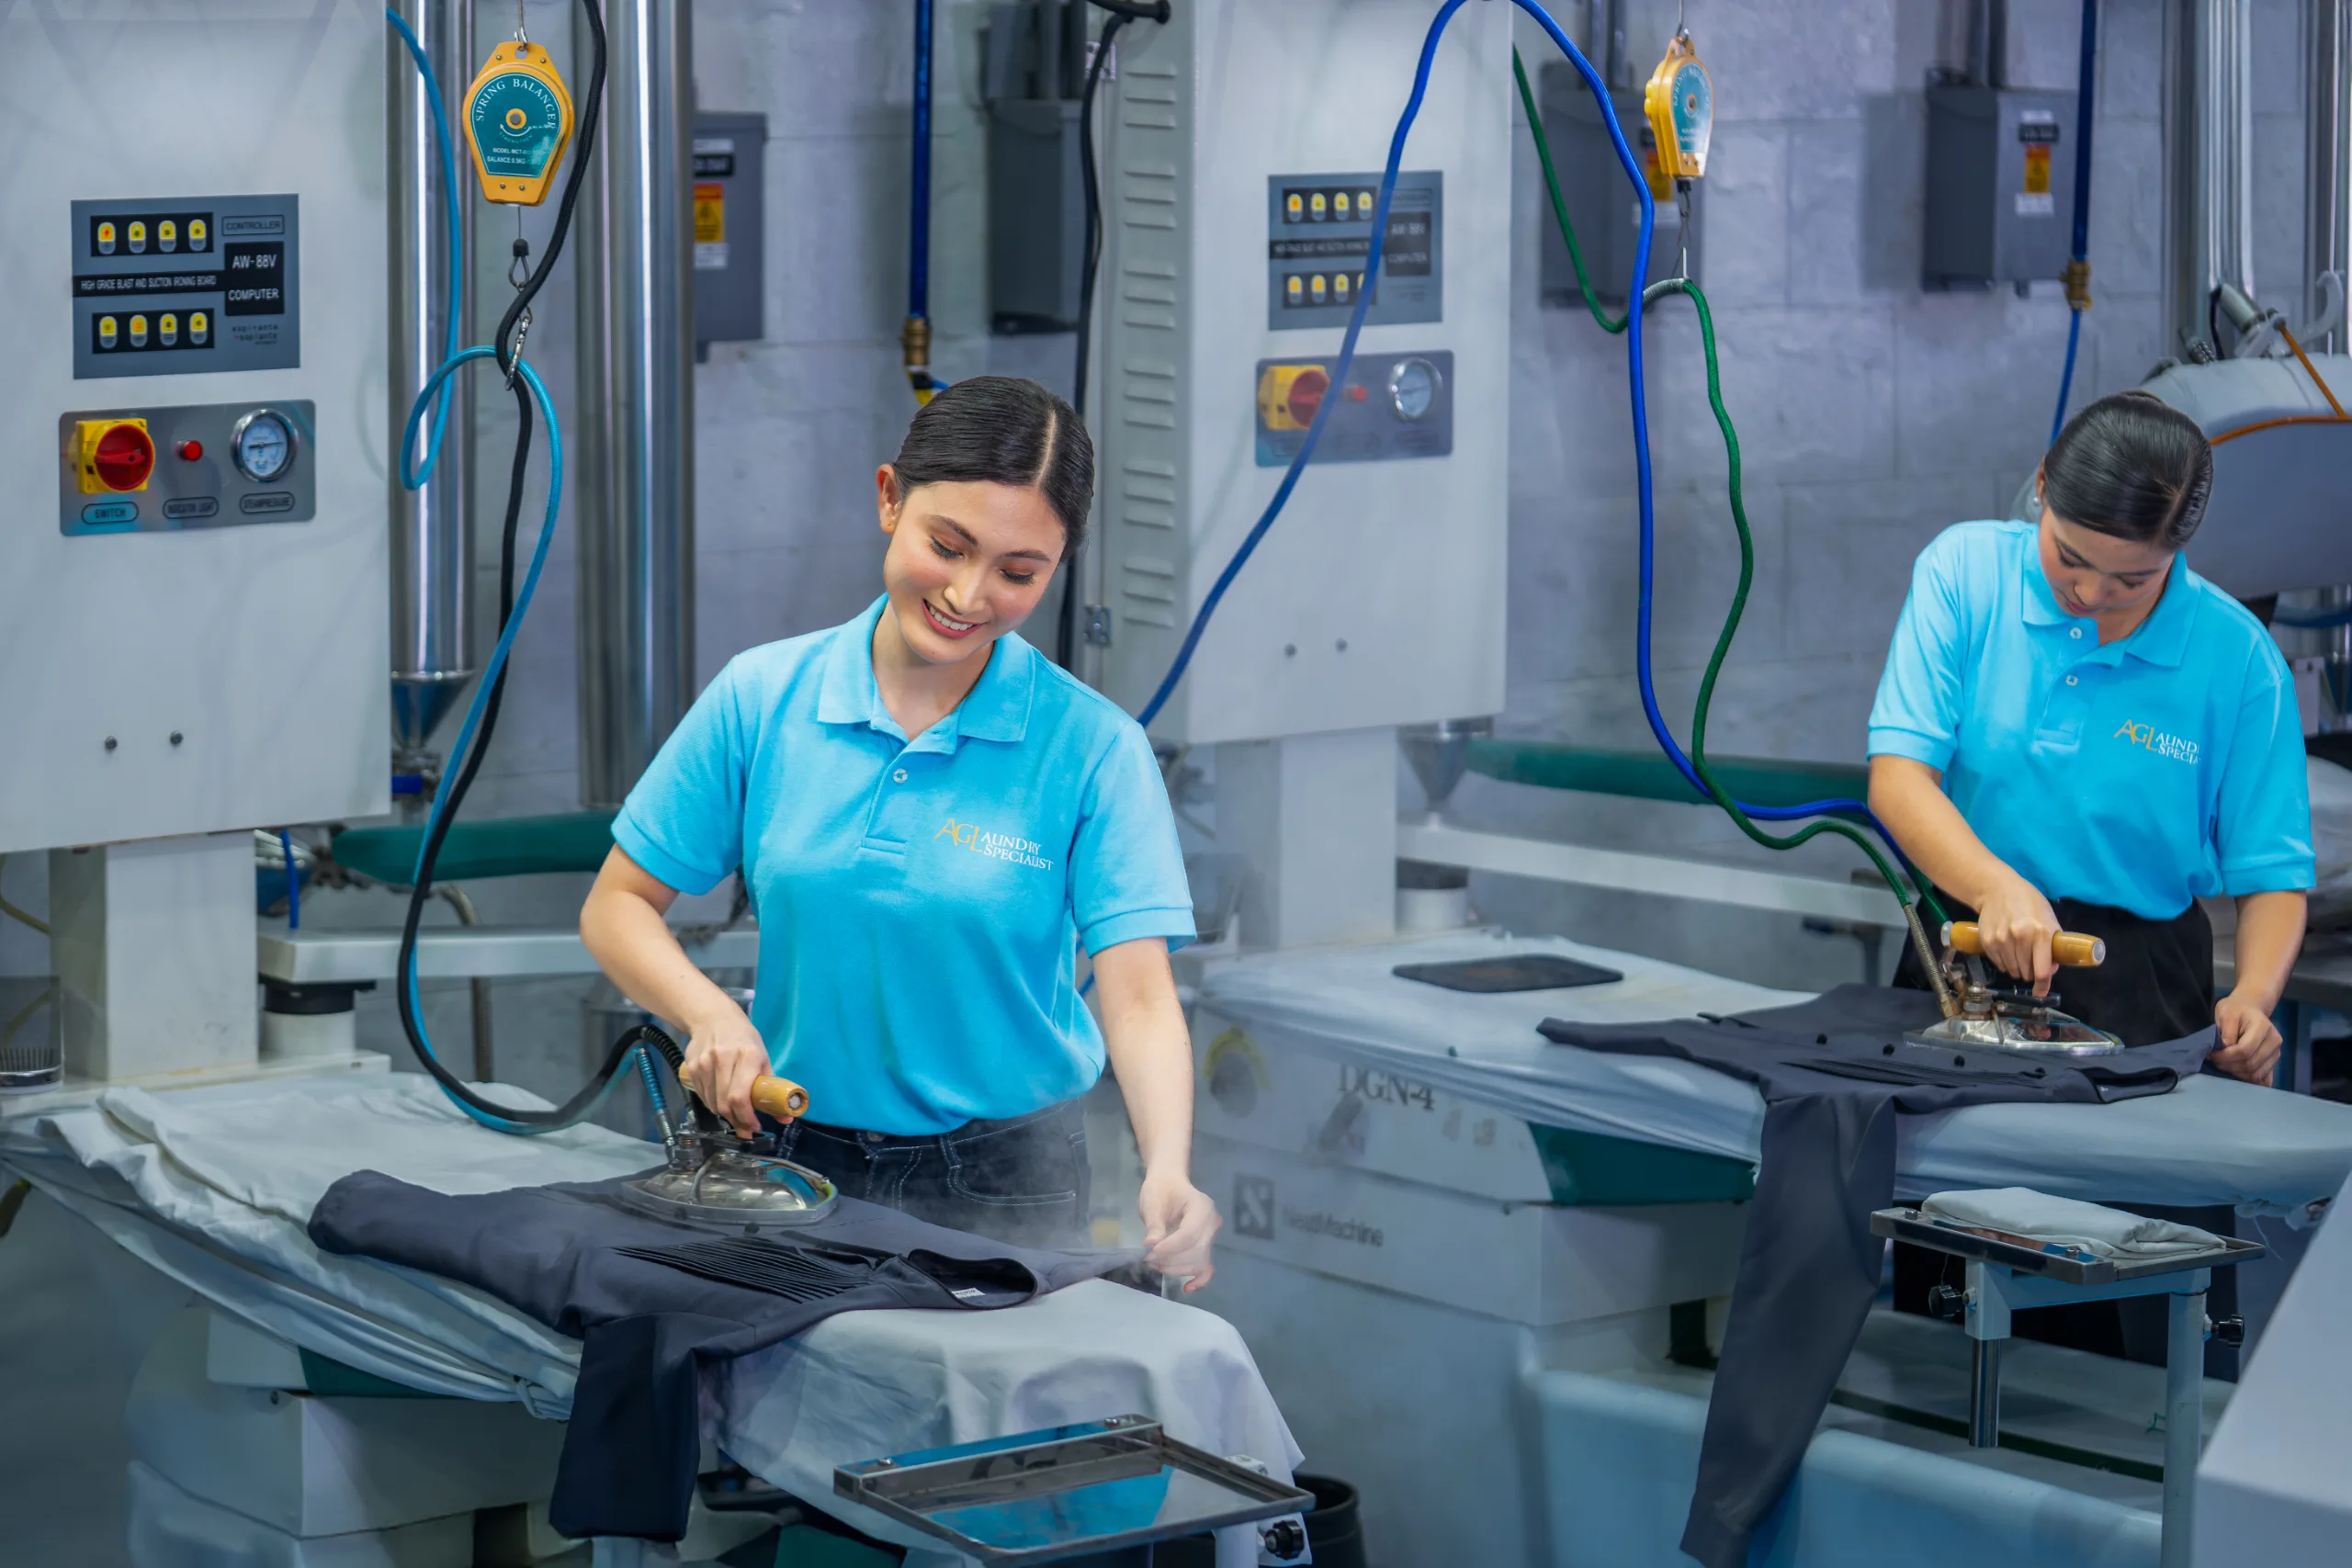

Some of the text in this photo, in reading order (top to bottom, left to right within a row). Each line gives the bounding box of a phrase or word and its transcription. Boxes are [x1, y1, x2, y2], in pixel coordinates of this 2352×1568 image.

[475, 78, 556, 130] SPRING BALANCER
[226, 220, 280, 230] CONTROLLER
[232, 254, 277, 269] AW-88V
[81, 280, 96, 290] HIGH
[96, 279, 116, 289] GRADE
[117, 278, 134, 288] BLAST
[135, 278, 147, 288] AND
[148, 276, 172, 288] SUCTION
[197, 276, 217, 286] BOARD
[228, 288, 279, 300] COMPUTER
[95, 507, 126, 518] SWITCH
[2157, 742, 2201, 765] SPECIA
[983, 843, 1054, 871] SPECIALIST
[1338, 1063, 1435, 1111] DGN-4
